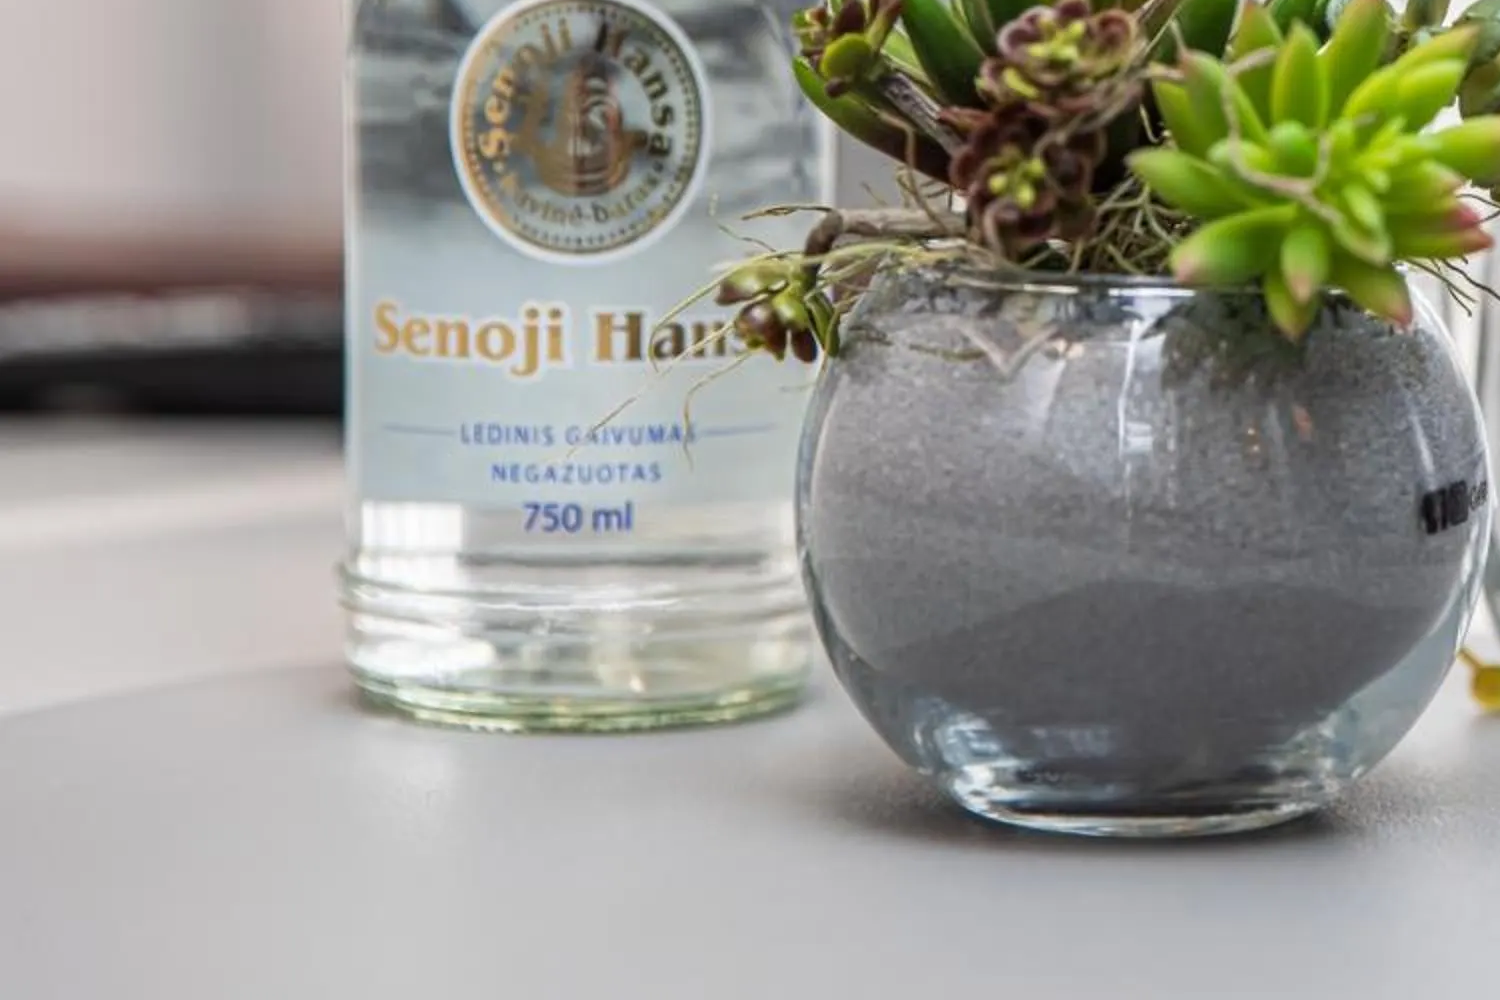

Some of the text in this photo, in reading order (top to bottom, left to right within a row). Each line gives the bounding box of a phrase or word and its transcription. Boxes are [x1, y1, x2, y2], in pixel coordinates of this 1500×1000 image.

[374, 302, 564, 377] Senoji
[460, 423, 555, 445] LEDINIS
[491, 463, 662, 485] NEGAZUOTAS
[523, 501, 633, 532] 750 ml
